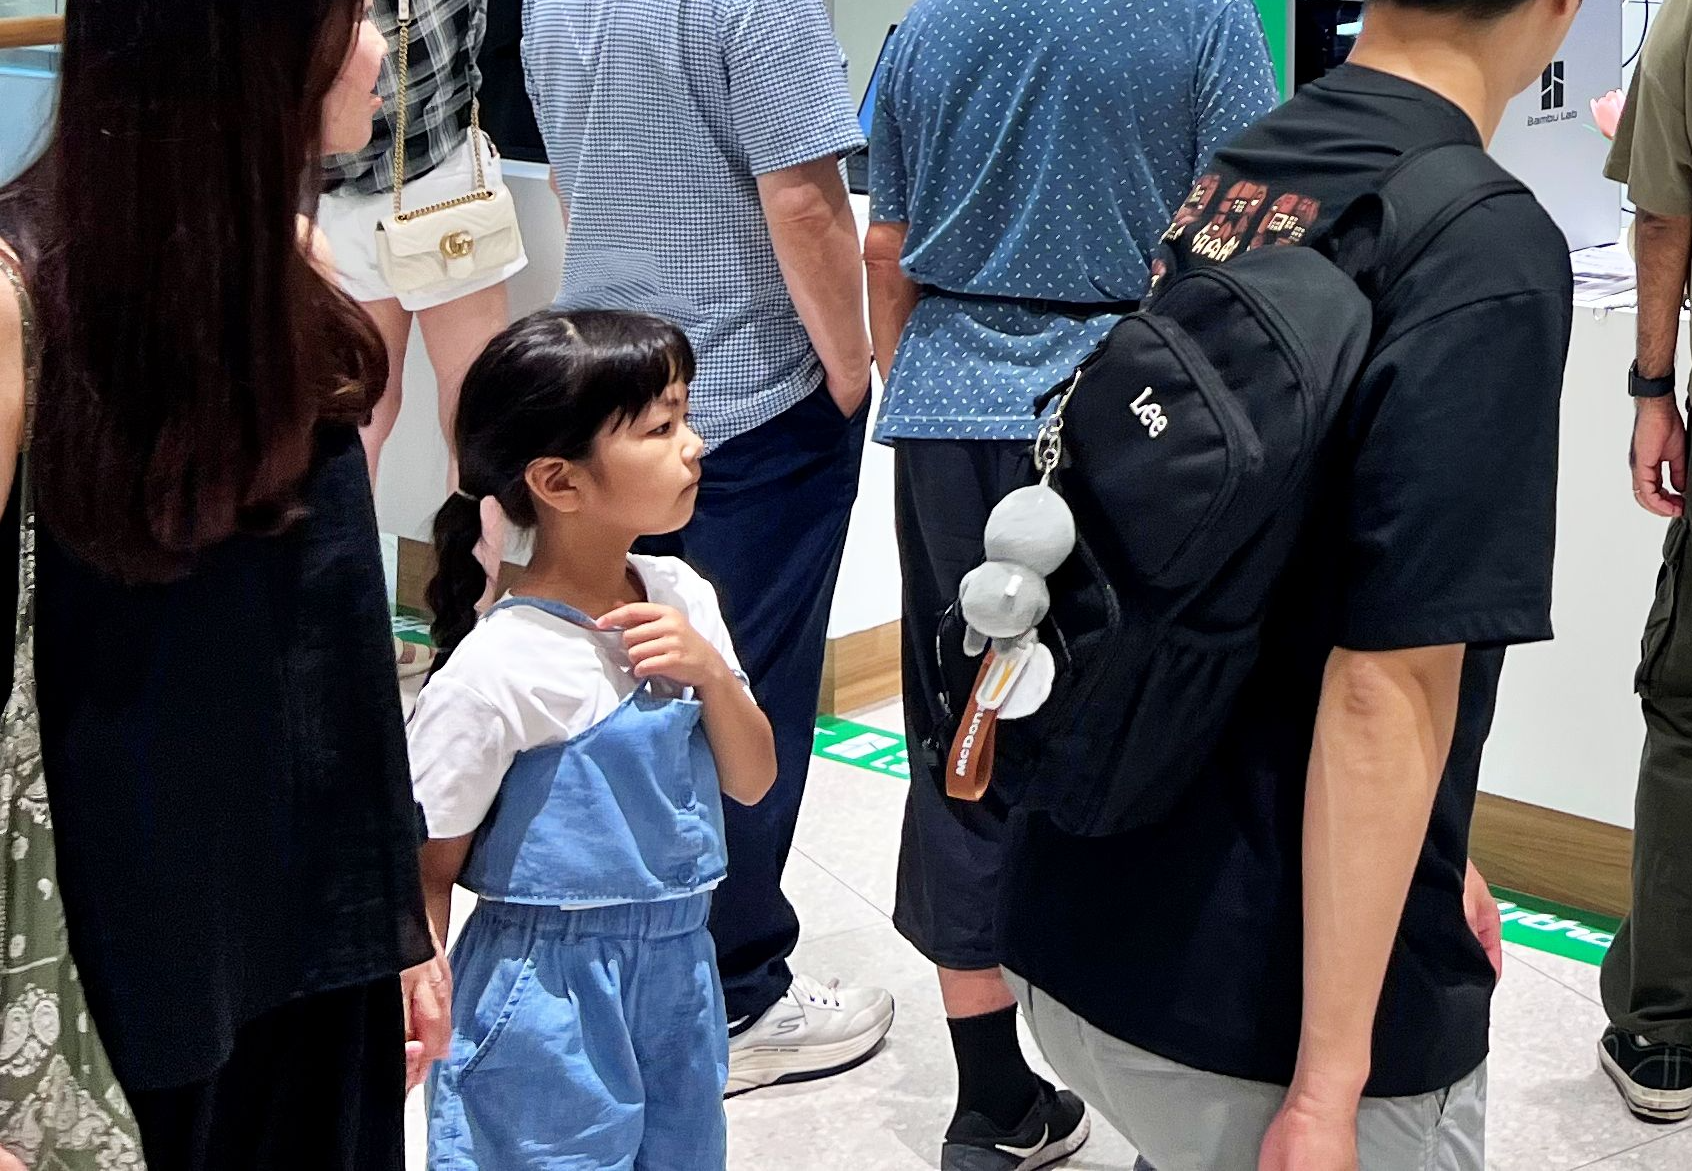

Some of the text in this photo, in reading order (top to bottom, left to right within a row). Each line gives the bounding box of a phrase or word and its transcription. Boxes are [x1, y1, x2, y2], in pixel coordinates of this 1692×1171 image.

[1527, 110, 1578, 127] Bambu Lab
[1128, 385, 1168, 439] Lee
[955, 710, 985, 777] McDon
